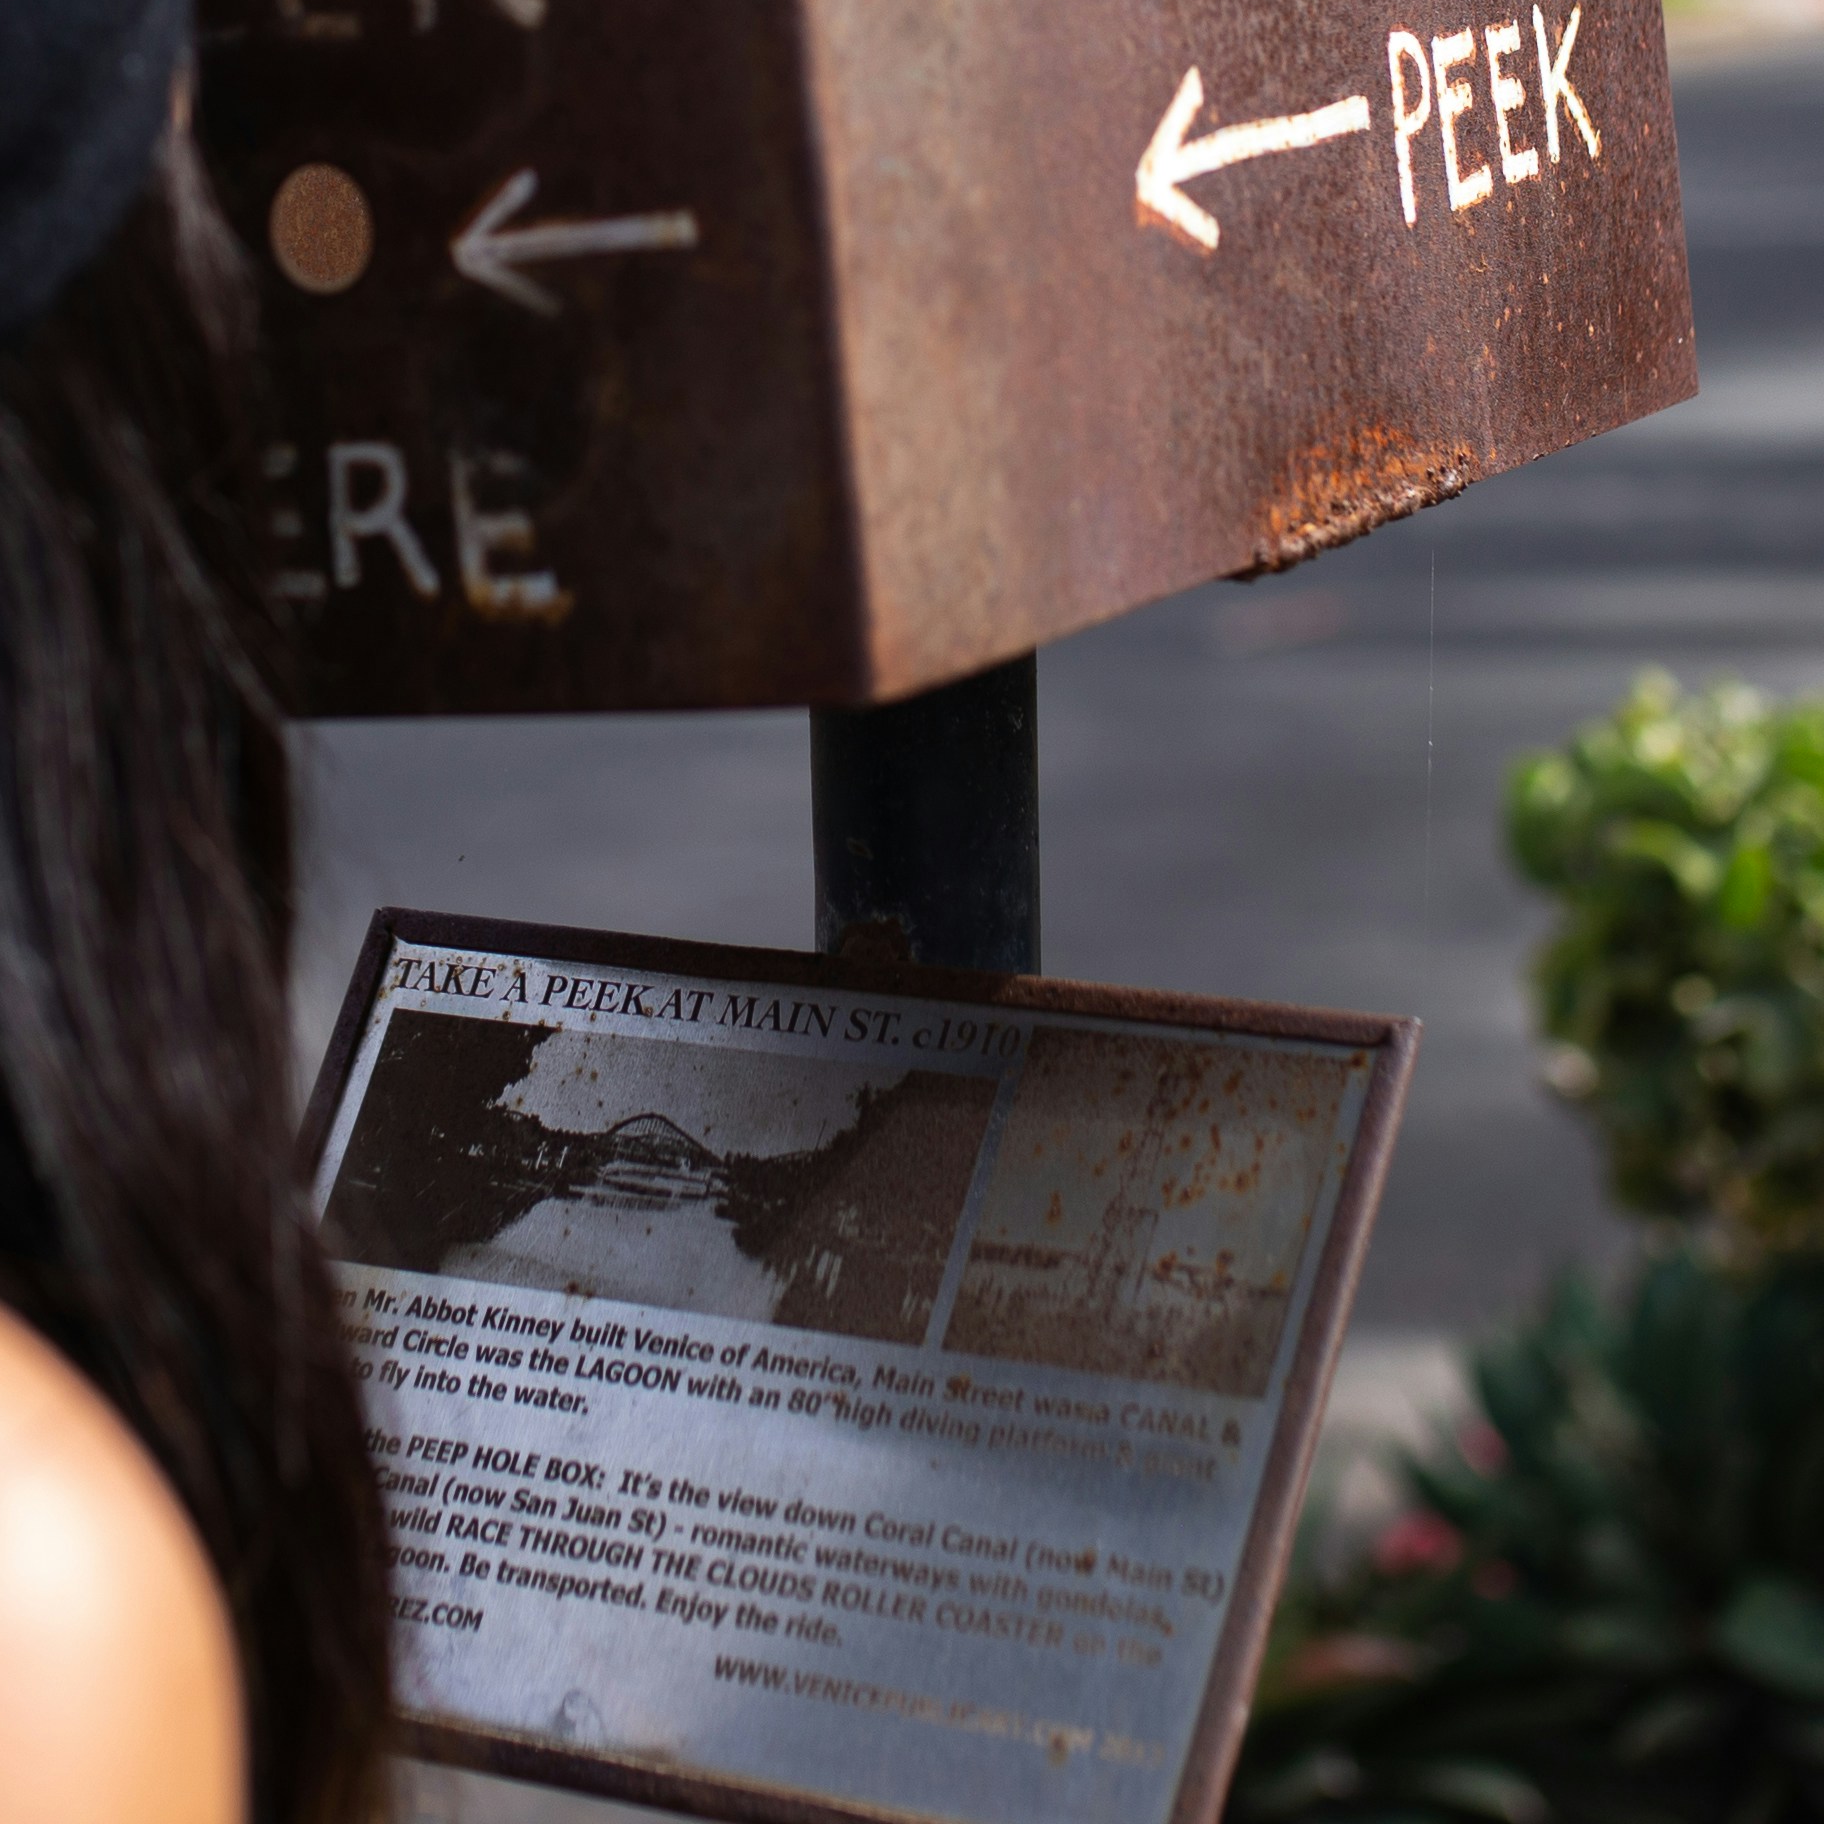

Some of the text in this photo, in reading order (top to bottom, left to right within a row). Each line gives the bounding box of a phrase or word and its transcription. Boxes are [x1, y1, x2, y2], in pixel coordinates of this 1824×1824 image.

[1388, 2, 1602, 227] PEEK
[262, 439, 564, 616] ERE
[395, 957, 1022, 1058] TAKE A PEEK AT MAIN ST. c1910
[339, 1324, 400, 1349] ward
[403, 1328, 470, 1360] Circle
[476, 1344, 524, 1368] was
[528, 1348, 569, 1375] the
[574, 1354, 682, 1394] LAGOON
[687, 1373, 742, 1405] with
[748, 1385, 781, 1410] an
[899, 1406, 981, 1445] diving
[351, 1356, 589, 1415] to fly into the water.
[363, 1288, 399, 1314] Mr.
[405, 1295, 478, 1327] Abbot
[481, 1305, 565, 1345] Kinney
[569, 1318, 628, 1349] built
[634, 1327, 714, 1363] Venice
[720, 1343, 750, 1367] of
[751, 1347, 862, 1390] America,
[872, 1364, 935, 1397] Main
[943, 1373, 1025, 1412] Street
[1119, 1400, 1209, 1441] CANAL
[363, 1428, 402, 1456] the
[405, 1434, 469, 1466] PEEP
[471, 1445, 540, 1478] HOLE
[543, 1457, 606, 1490] BOX:
[617, 1468, 663, 1500] It's
[668, 1478, 711, 1508] the
[717, 1487, 779, 1519] view
[783, 1498, 857, 1535] down
[864, 1510, 936, 1550] Coral
[941, 1525, 1020, 1562] Canal
[375, 1467, 440, 1498] Canal
[442, 1476, 507, 1509] (now
[510, 1488, 557, 1518] San
[561, 1497, 622, 1528] Juan
[627, 1507, 667, 1541] St)
[690, 1523, 809, 1563] romantic
[814, 1544, 961, 1592] waterways
[968, 1571, 1029, 1602] with
[381, 1546, 449, 1576] goon.
[459, 1551, 491, 1579] Be
[496, 1560, 647, 1609] transported.
[655, 1587, 728, 1630] Enjoy
[734, 1602, 779, 1634] the
[390, 1508, 443, 1534] wild
[445, 1514, 514, 1547] RACE
[518, 1525, 645, 1572] THROUGH
[651, 1547, 703, 1581] THE
[706, 1558, 817, 1602] CLOUDS
[821, 1579, 928, 1624] ROLLER
[935, 1600, 1065, 1648] COASTER
